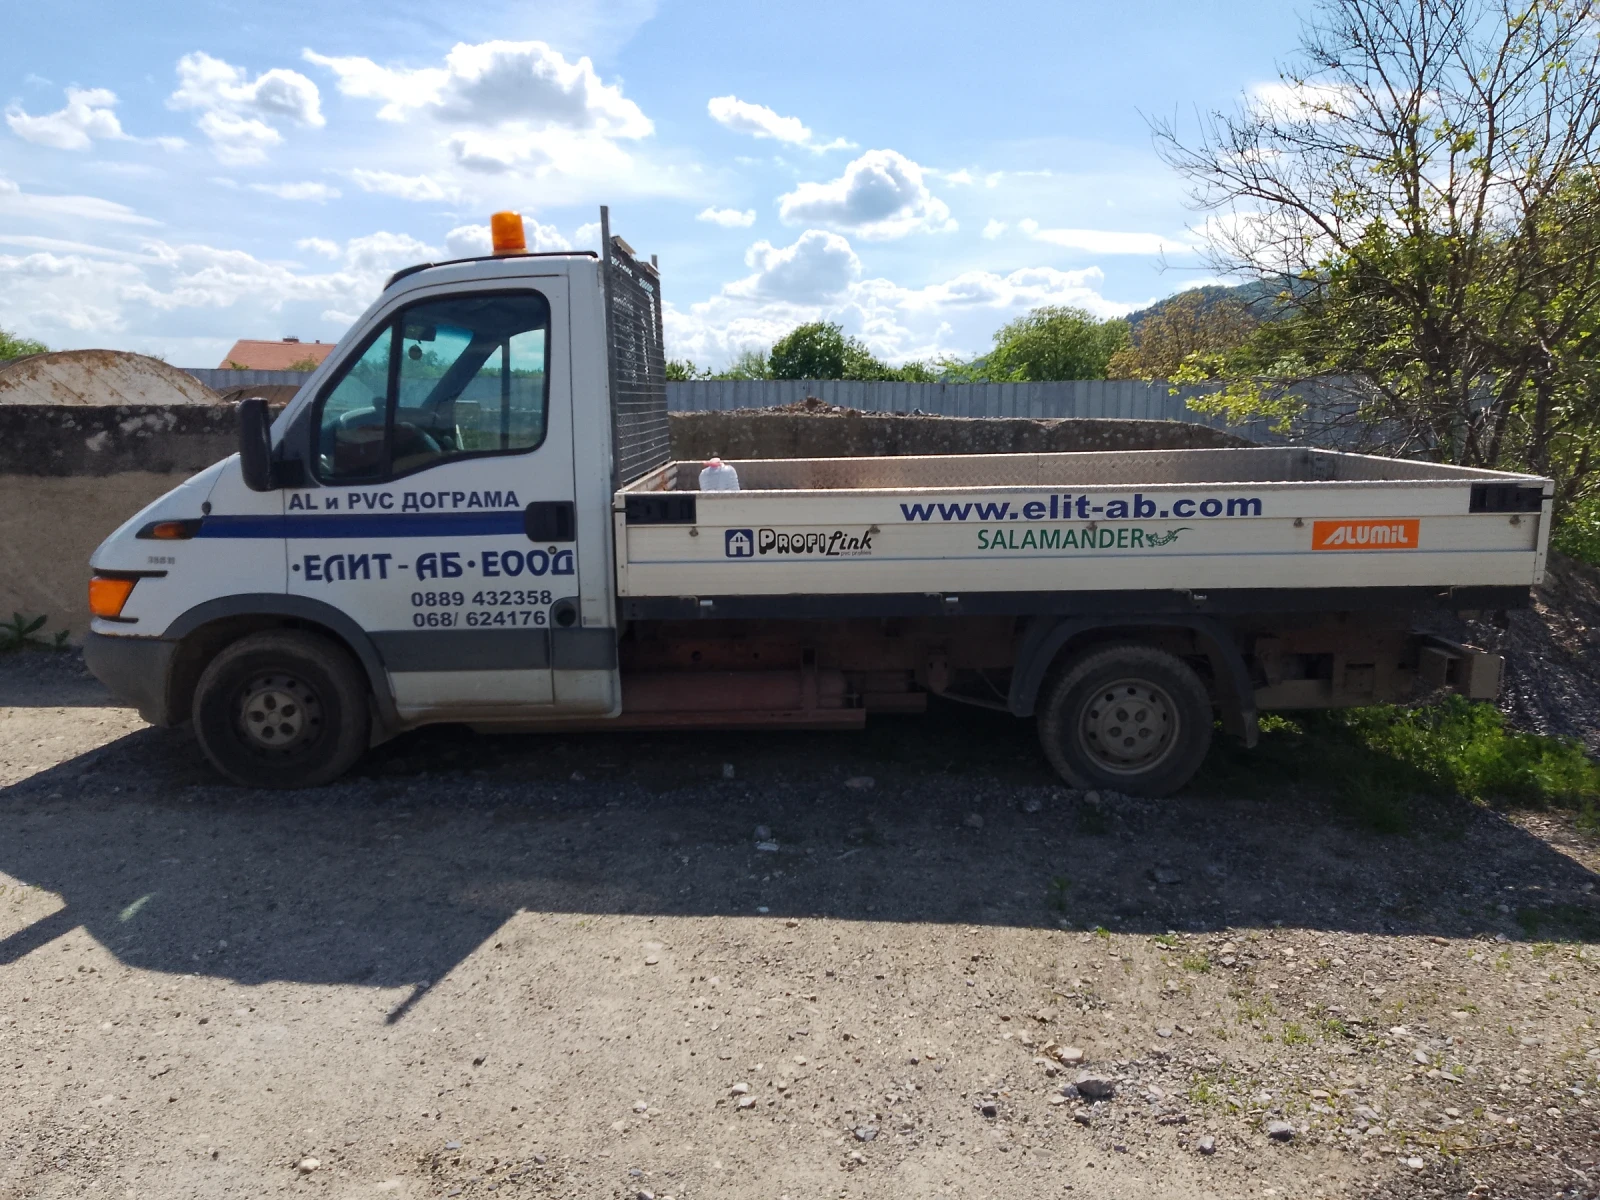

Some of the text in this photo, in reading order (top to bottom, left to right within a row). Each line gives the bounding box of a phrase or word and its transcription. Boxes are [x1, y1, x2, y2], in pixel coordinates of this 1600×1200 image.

[289, 491, 520, 512] AL и PVC ДОГРАМА
[900, 494, 1262, 521] www.elit-ab.com
[977, 528, 1145, 550] SALAMANDER
[411, 590, 554, 606] 0889 432358
[413, 611, 546, 627] 068/ 624176
